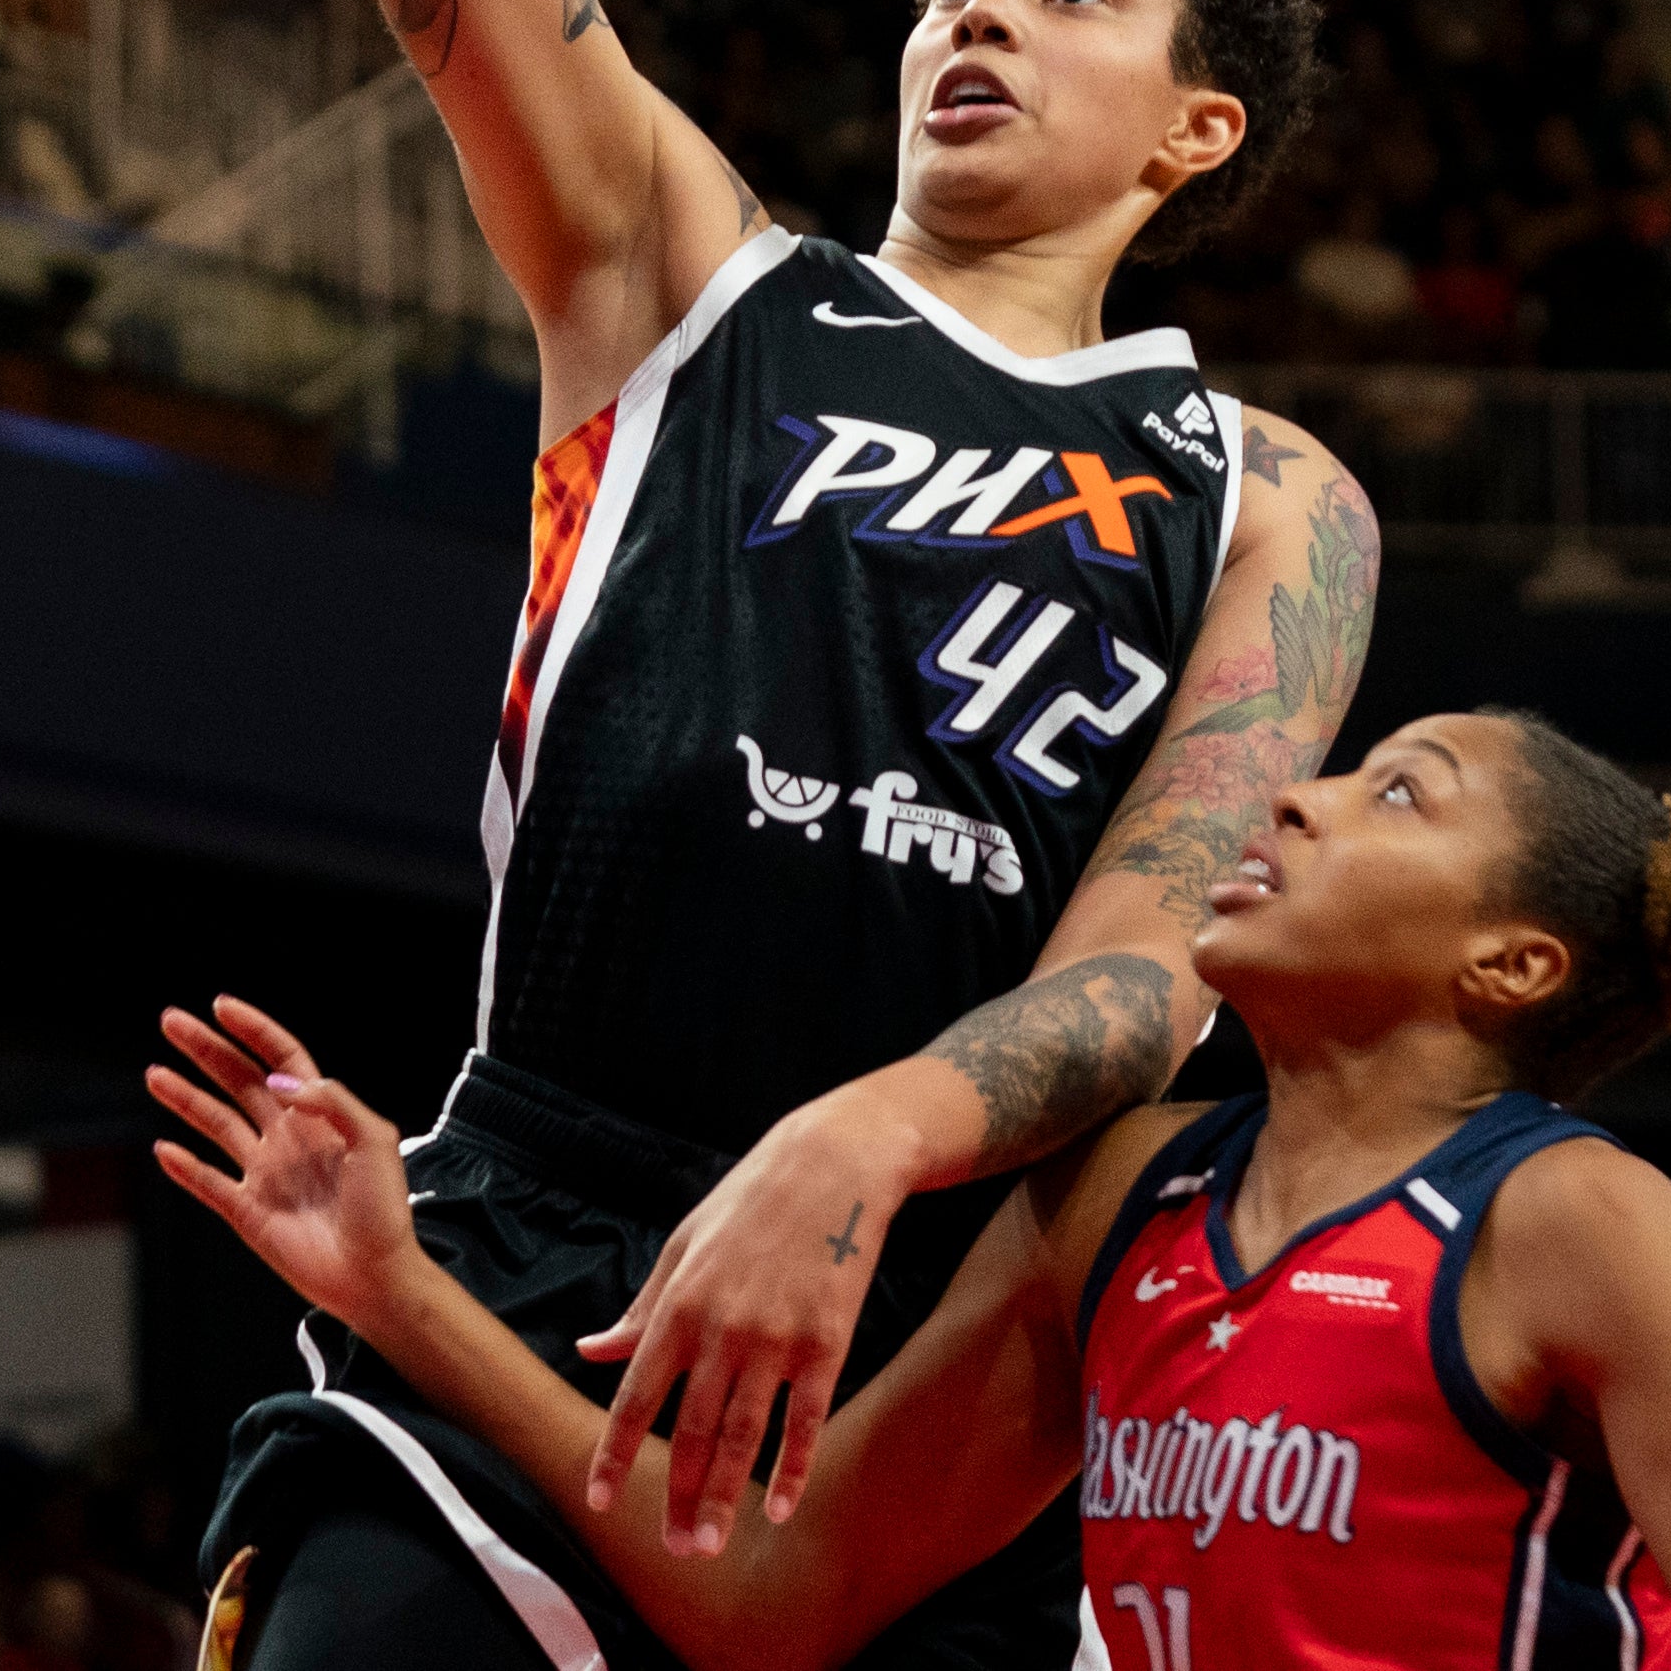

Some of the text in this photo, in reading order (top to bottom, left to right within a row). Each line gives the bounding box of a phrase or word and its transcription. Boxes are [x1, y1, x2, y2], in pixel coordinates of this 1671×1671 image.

[743, 414, 1173, 569] PHX
[1142, 411, 1226, 473] PayPal
[918, 577, 1168, 796] 42
[848, 770, 1024, 896] fry's
[894, 803, 948, 826] FOOD
[1080, 1380, 1361, 1549] ashington
